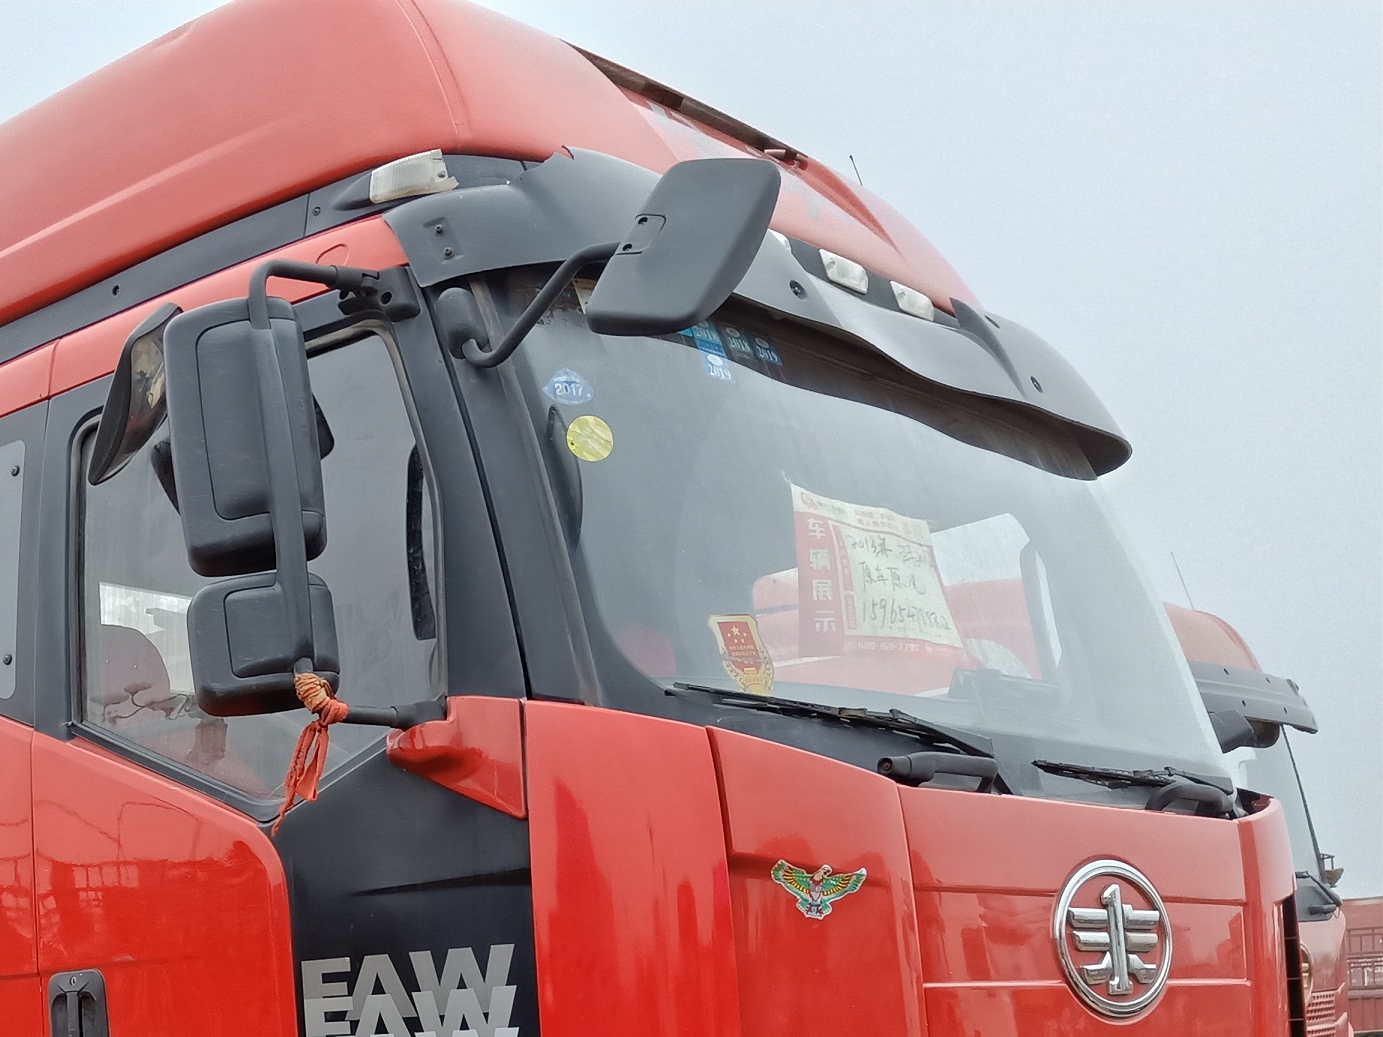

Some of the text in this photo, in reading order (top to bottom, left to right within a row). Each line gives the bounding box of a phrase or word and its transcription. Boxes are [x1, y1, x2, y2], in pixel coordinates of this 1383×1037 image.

[554, 382, 583, 397] 2017
[806, 517, 838, 633] 车辆展示
